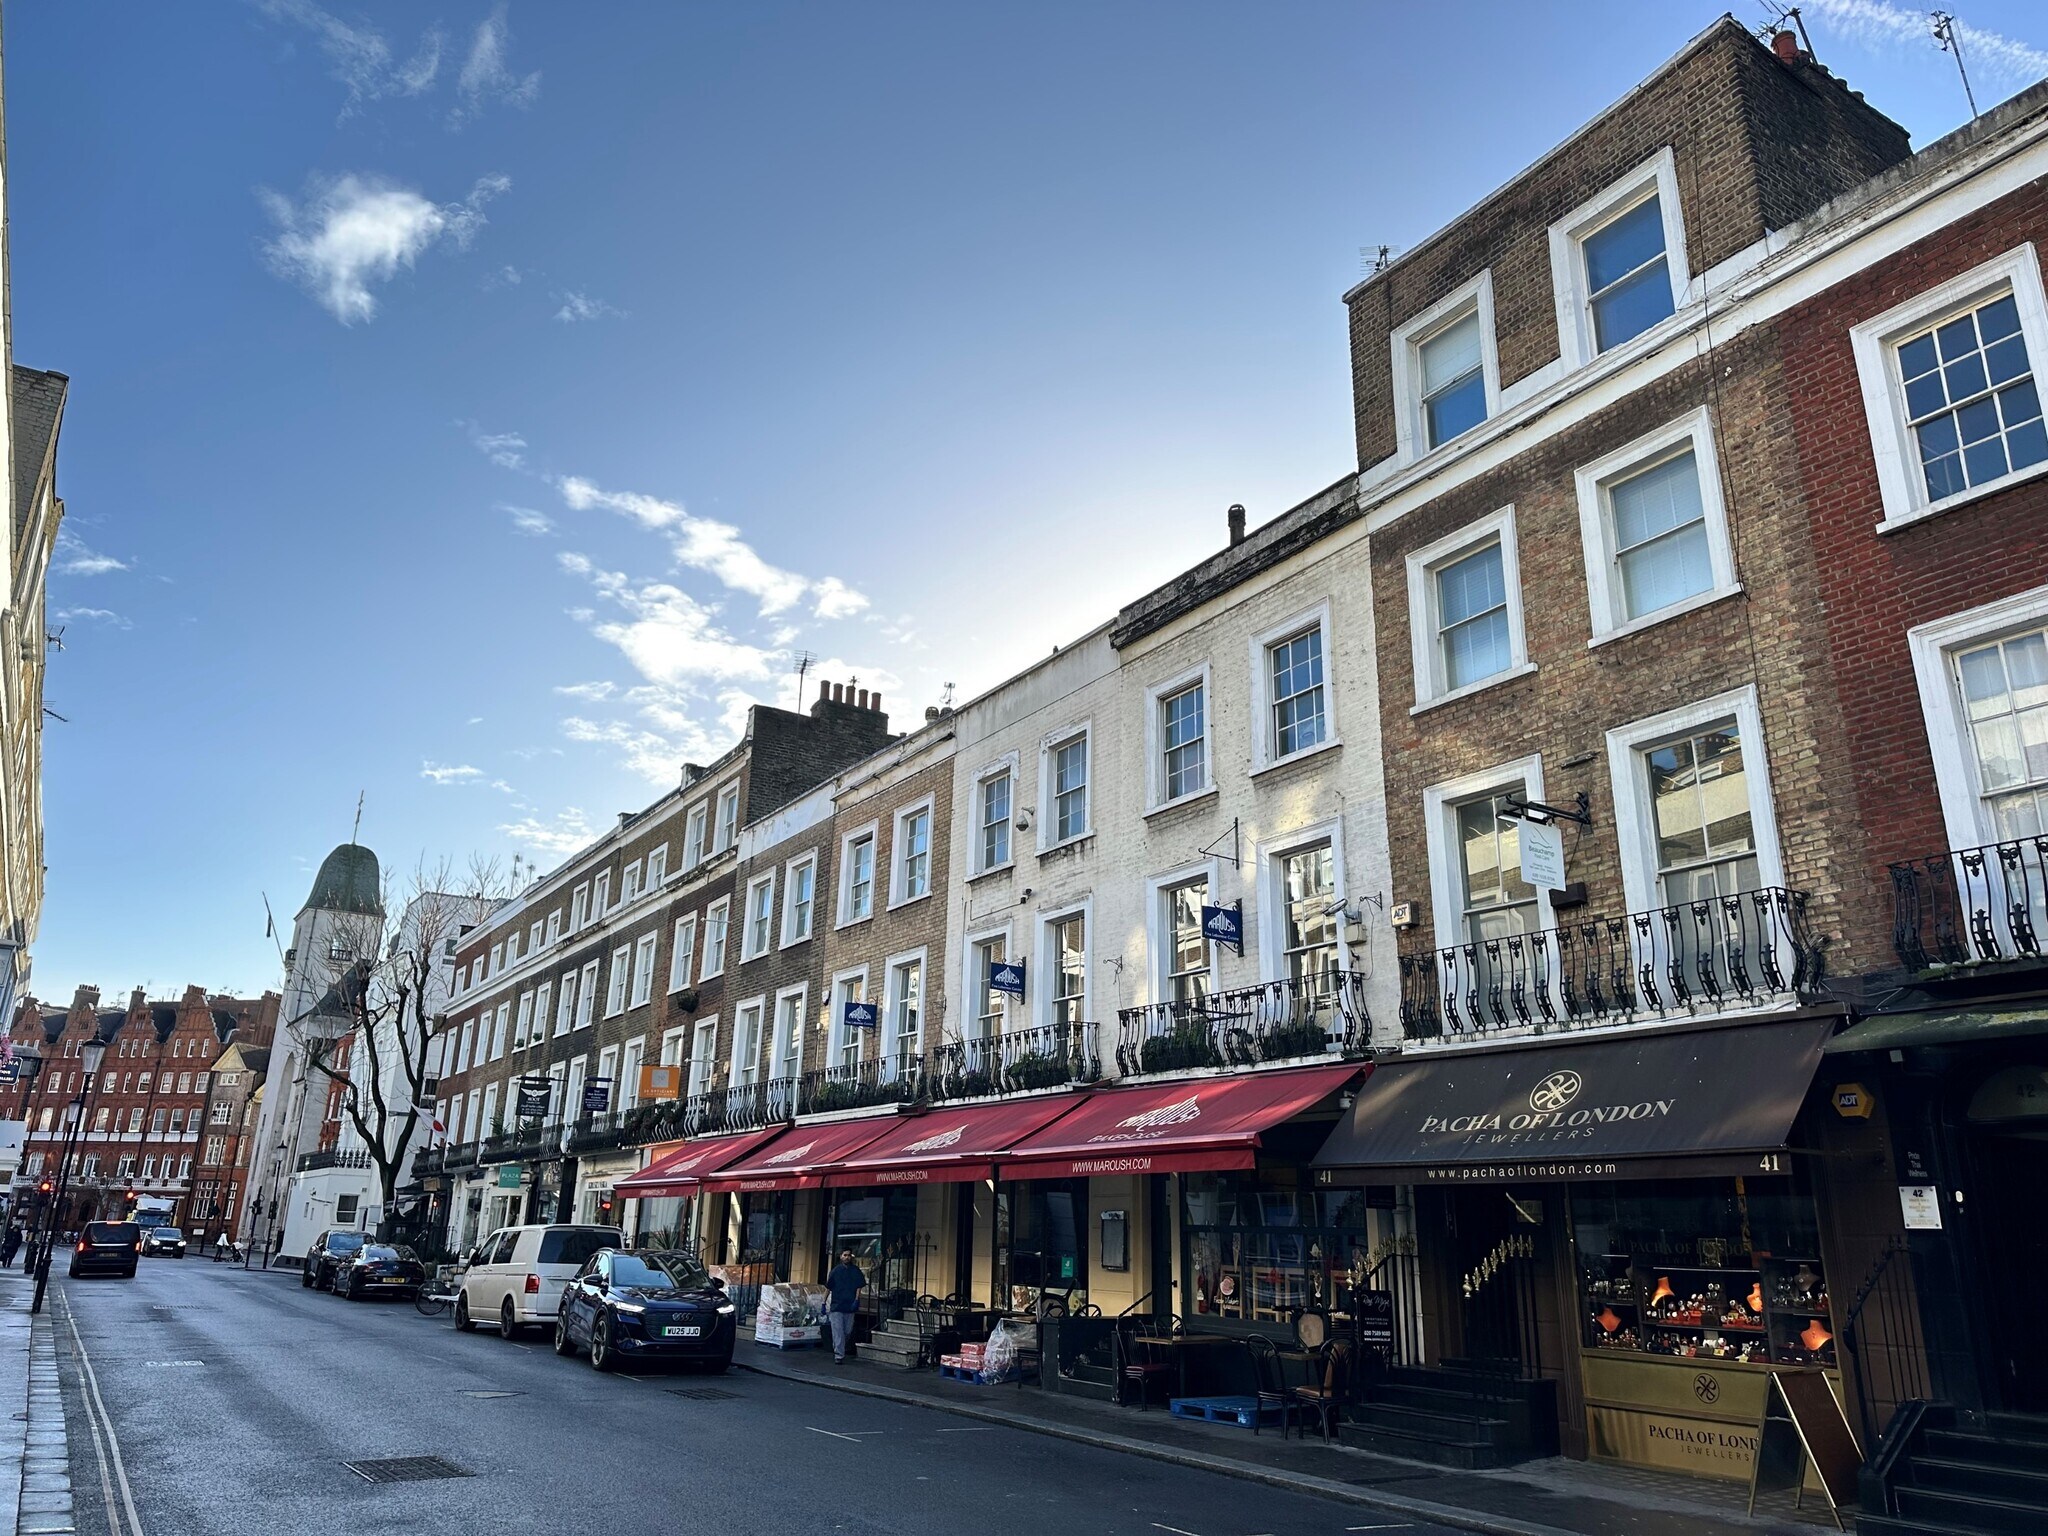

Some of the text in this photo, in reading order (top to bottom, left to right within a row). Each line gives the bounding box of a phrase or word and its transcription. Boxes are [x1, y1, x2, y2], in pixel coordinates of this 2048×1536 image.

[1394, 906, 1408, 918] ADT
[1840, 1094, 1858, 1105] ADT
[1418, 1099, 1676, 1133] PACHA OF LONDON
[1463, 1127, 1595, 1145] JEWELLERS
[1072, 1158, 1152, 1173] WWW.MAROUSH.COM
[1760, 1154, 1780, 1171] 41
[876, 1170, 929, 1182] WWW.MAROUSH.COM
[1320, 1170, 1332, 1183] 41
[1427, 1162, 1616, 1180] www.pachaoflondon.com
[1913, 1190, 1924, 1198] 42
[667, 1327, 685, 1335] WU25
[1648, 1424, 1694, 1443] PACHA
[1697, 1431, 1715, 1445] OF
[1681, 1444, 1750, 1462] JEWELLERS
